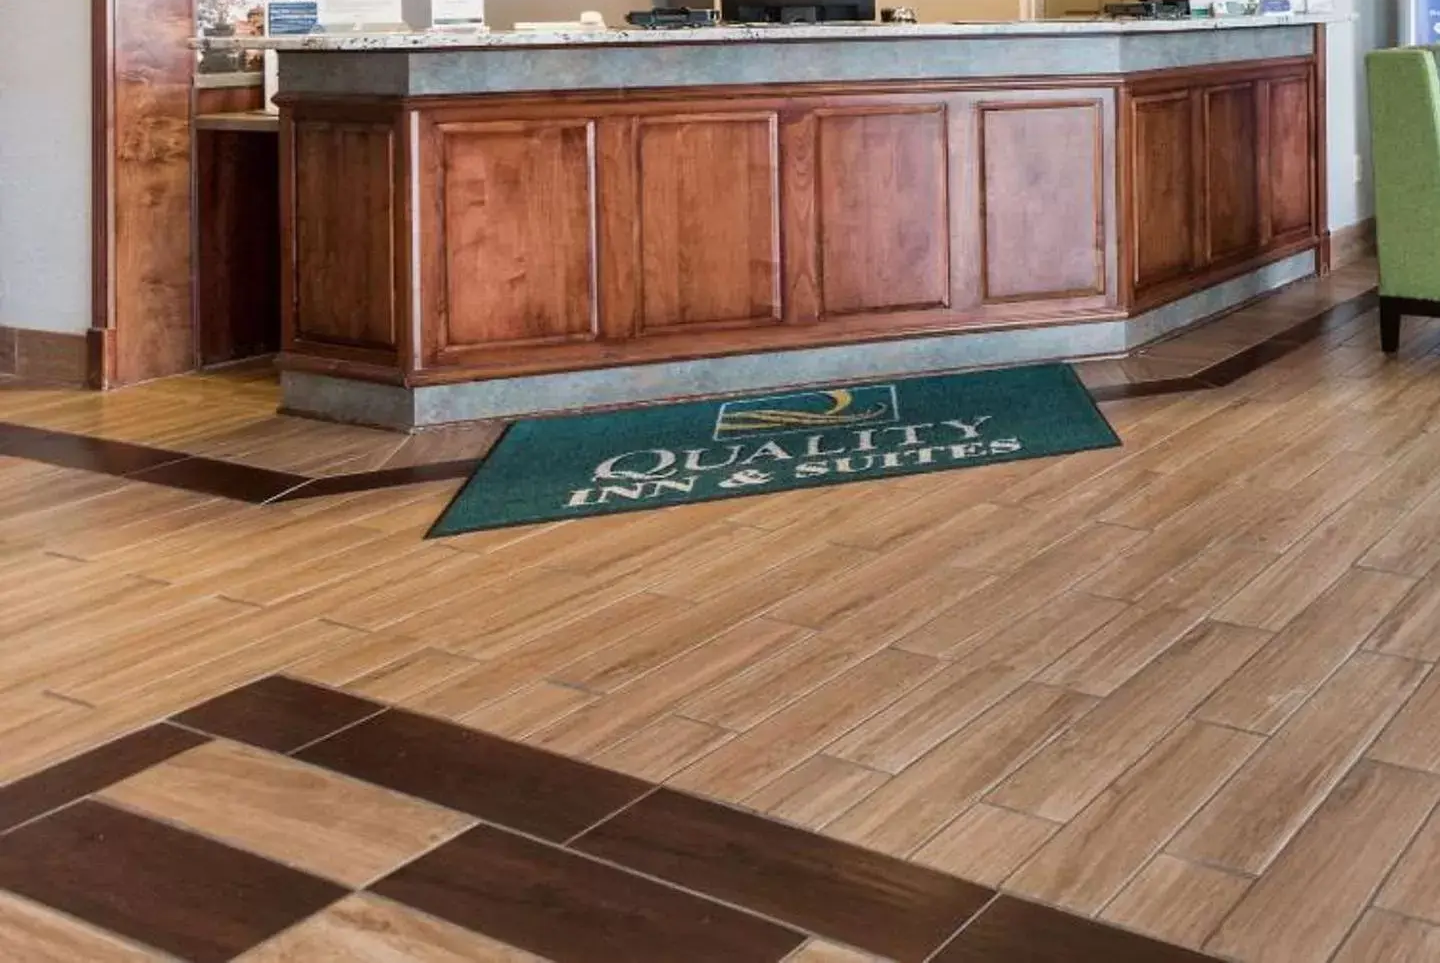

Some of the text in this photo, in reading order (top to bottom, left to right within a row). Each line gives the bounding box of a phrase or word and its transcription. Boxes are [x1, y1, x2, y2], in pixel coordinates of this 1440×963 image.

[562, 437, 1022, 510] INN & SUITES
[591, 415, 993, 480] QUALITY
